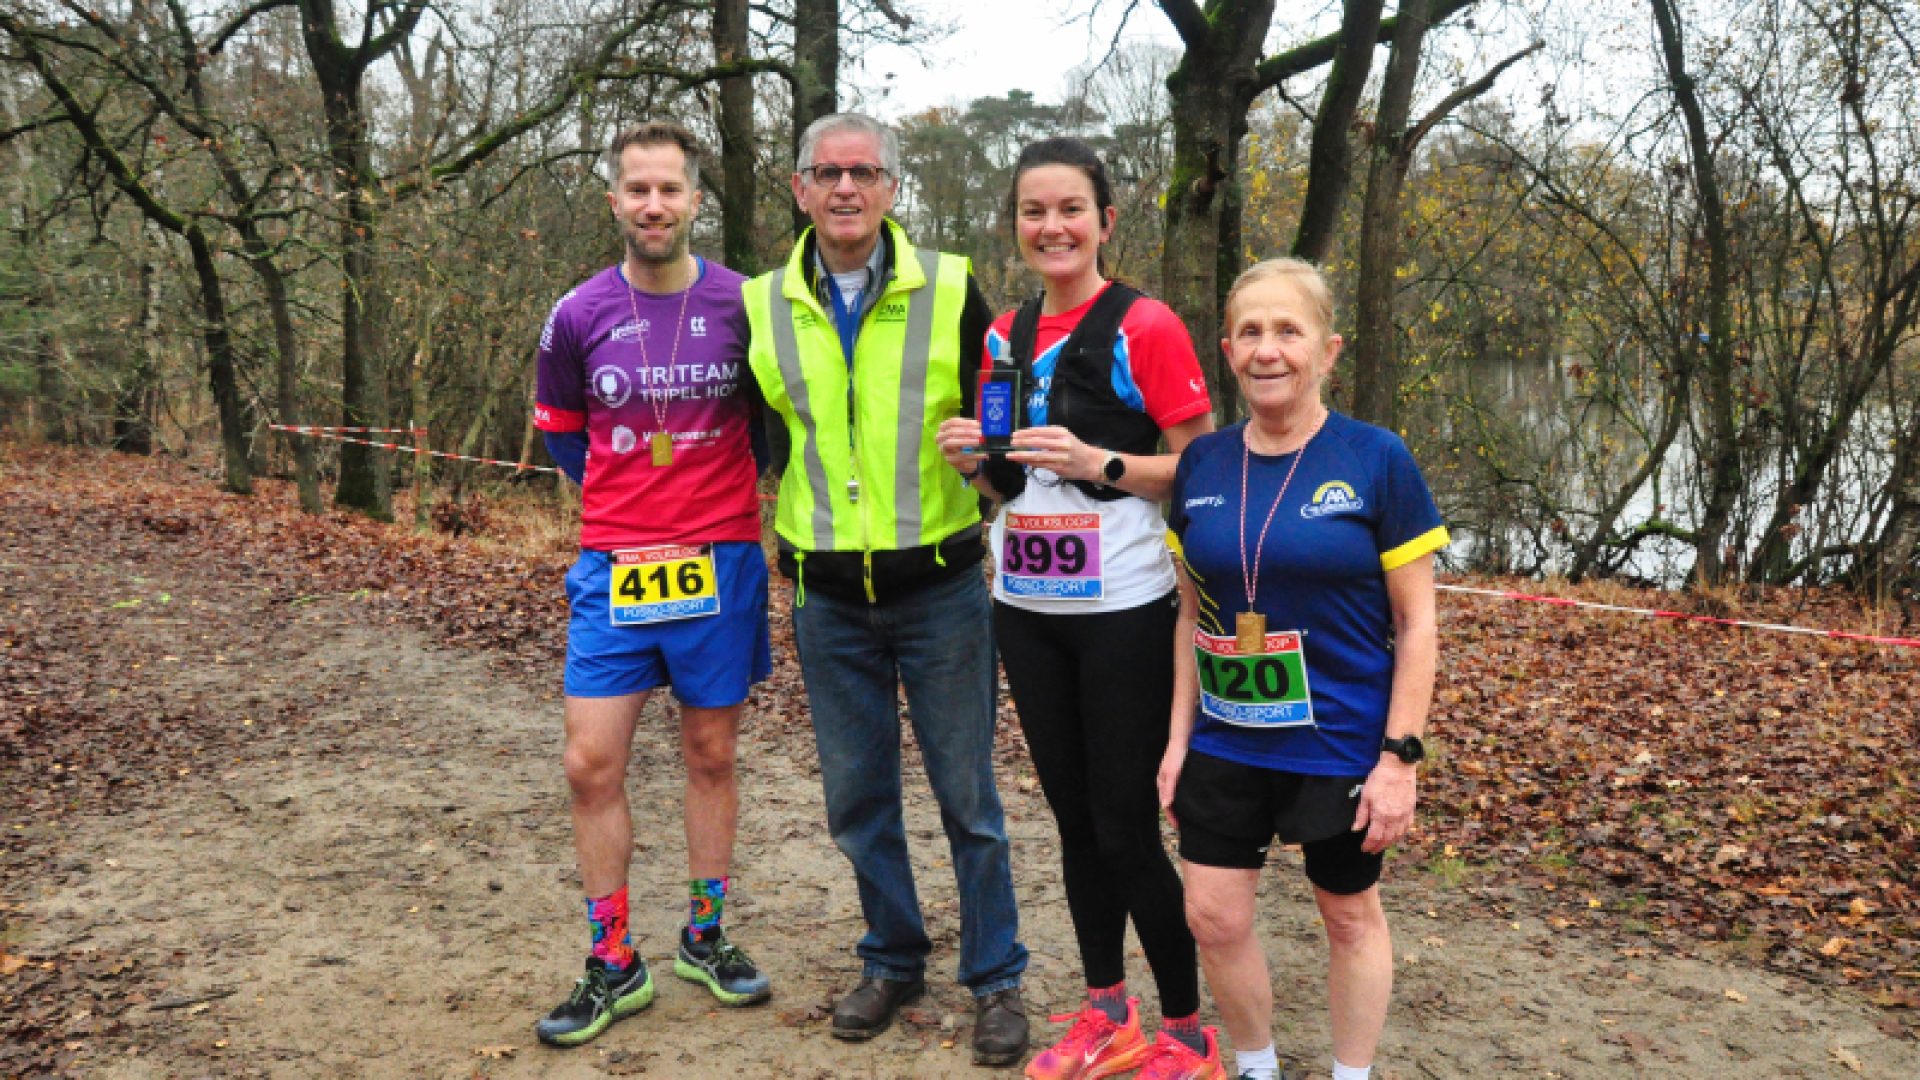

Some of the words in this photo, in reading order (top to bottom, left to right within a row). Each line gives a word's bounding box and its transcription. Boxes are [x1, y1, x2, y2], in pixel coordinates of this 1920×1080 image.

[635, 362, 740, 385] TRITEAM
[640, 386, 701, 402] TRIPEL
[1007, 534, 1087, 575] 399
[618, 562, 704, 601] 416
[623, 600, 704, 618] POSNO-SPORT
[1202, 655, 1290, 700] 120
